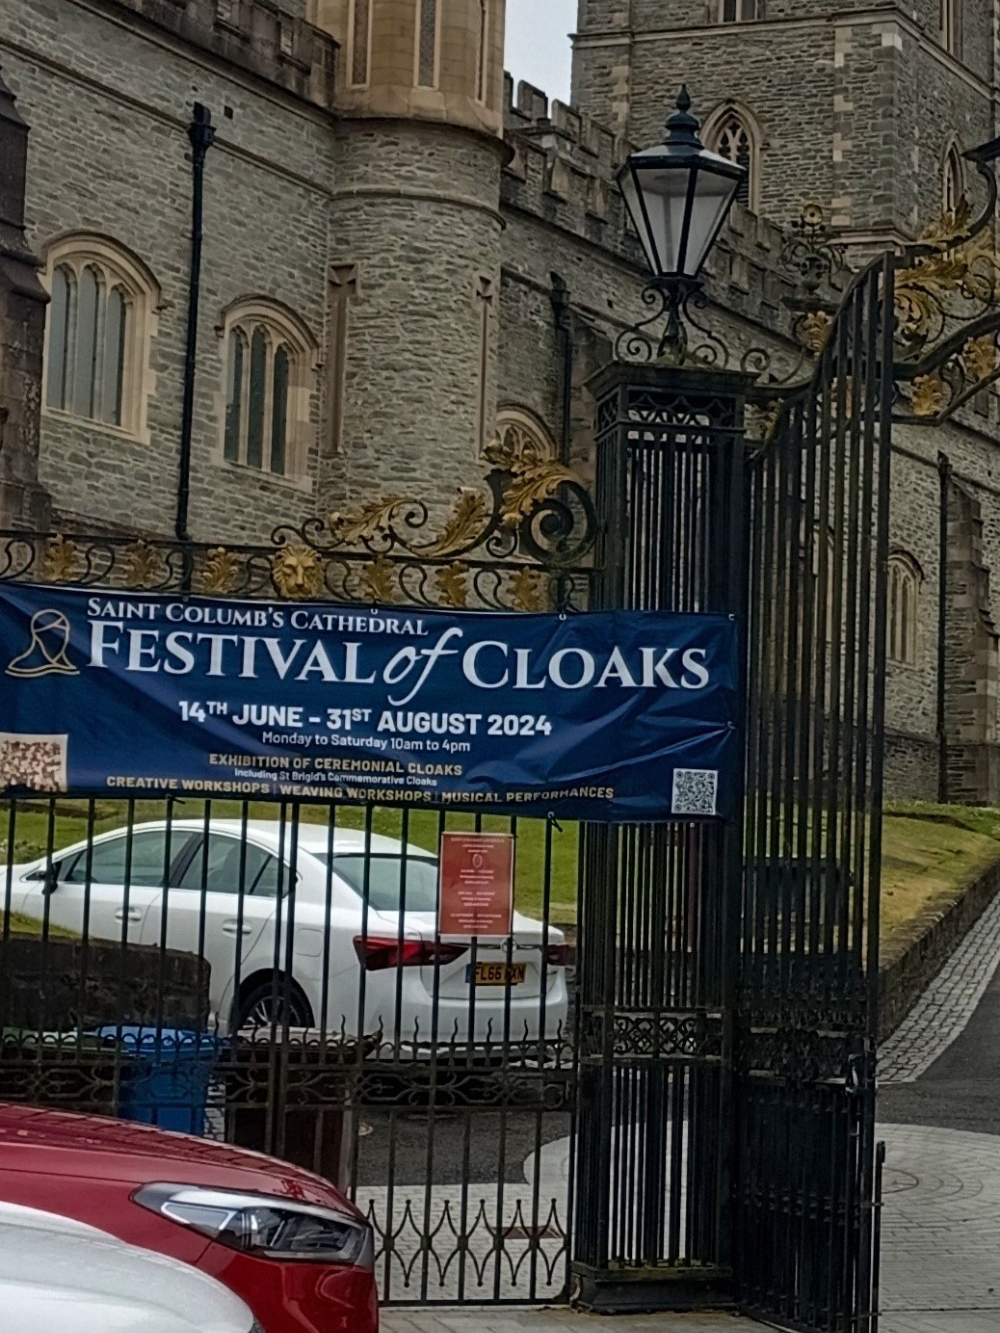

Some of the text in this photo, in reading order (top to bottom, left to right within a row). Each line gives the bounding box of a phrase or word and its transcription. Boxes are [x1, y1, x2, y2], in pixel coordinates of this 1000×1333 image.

[87, 597, 429, 636] SAINT COLUMB'S CATHEDRAL
[86, 618, 709, 706] FESTIVAL of CLOAKS
[179, 701, 228, 723] 14TH
[232, 704, 303, 728] JUNE
[326, 708, 372, 730] 31ST
[377, 710, 482, 735] AUGUST
[487, 714, 552, 736] 2024
[262, 731, 470, 754] Monday to Saturday 10am to 4pm
[209, 753, 462, 776] EXHIBITION OF CEREMONIAL CLOAKS
[235, 768, 437, 786] Including St Brigid's Commemorative Cloaks
[107, 776, 614, 803] CREATIVE WORKSHOPS WEAVING WORKSHOPS MUSICAL PERFORMANCES
